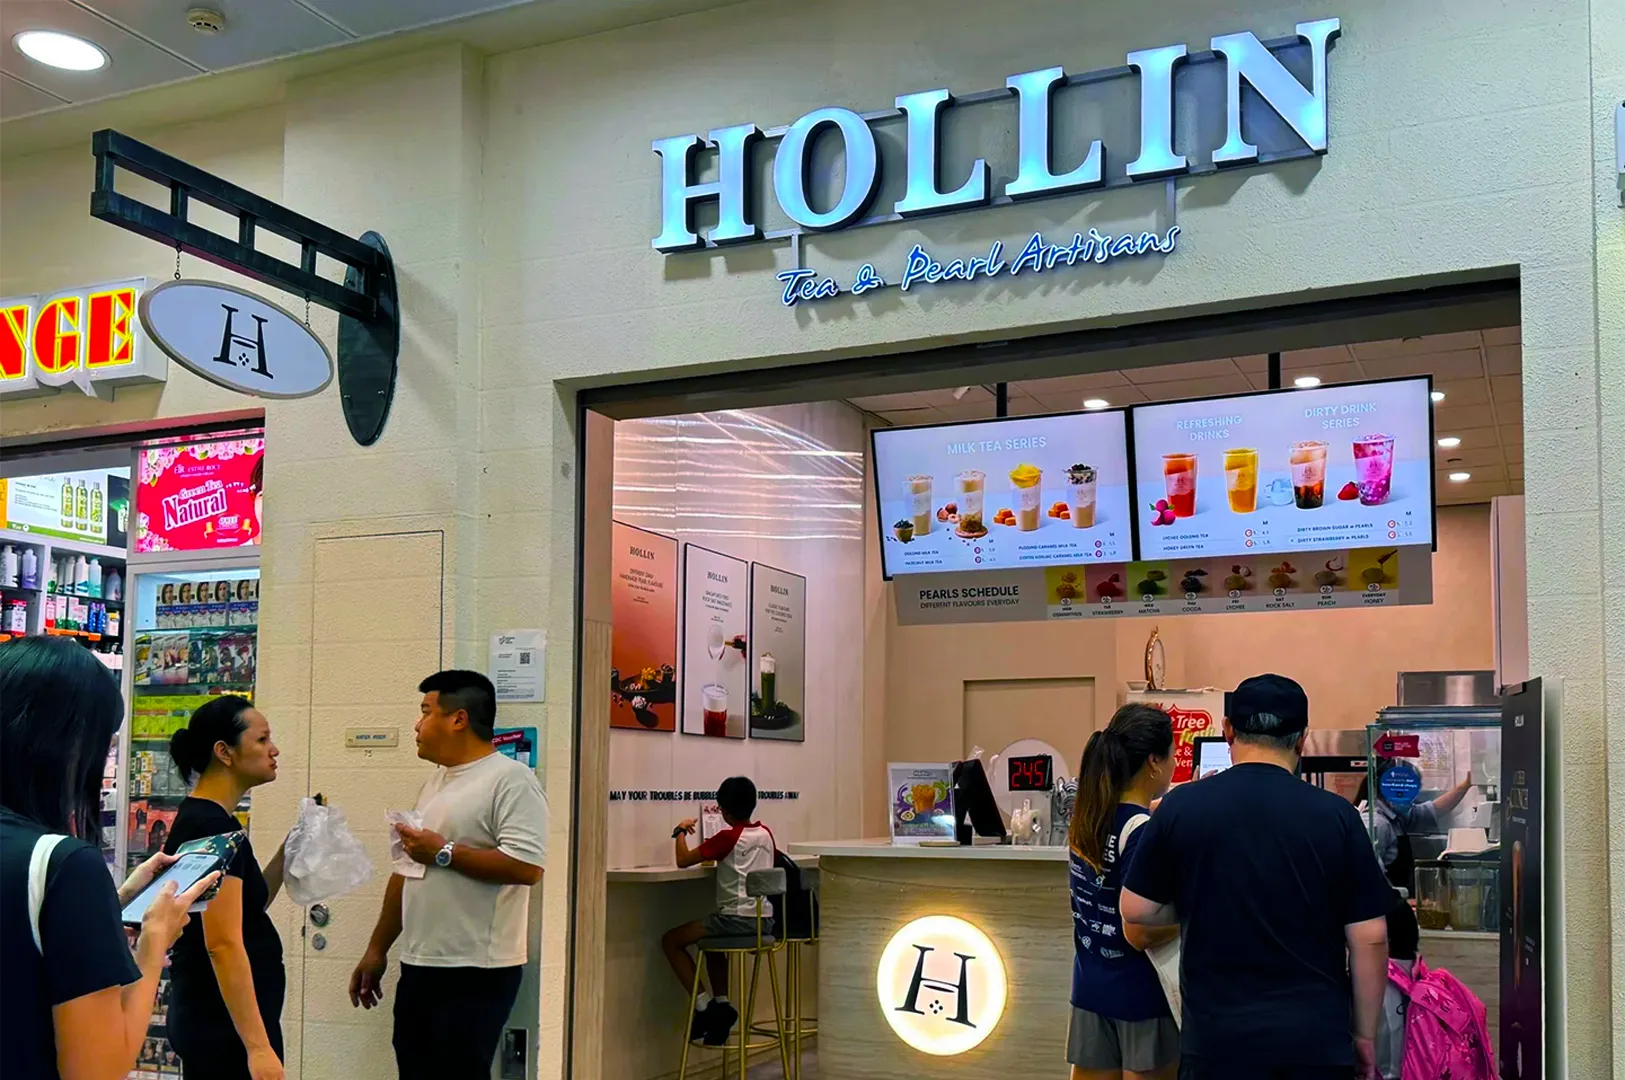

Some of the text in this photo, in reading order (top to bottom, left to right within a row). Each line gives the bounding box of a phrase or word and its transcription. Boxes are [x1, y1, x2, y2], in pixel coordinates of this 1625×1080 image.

[651, 17, 1342, 252] HOLLIN
[777, 225, 1181, 307] Tea & Pearl Artisans
[213, 303, 274, 379] H
[1305, 402, 1377, 418] DIRTY DRINK
[1177, 416, 1243, 430] REFRESHING
[1321, 417, 1360, 430] SERIES
[1190, 429, 1230, 441] DRINKS
[947, 436, 1047, 454] MILK TEA SERIES
[161, 488, 228, 531] Natural
[919, 585, 1019, 600] PEARLS SCHEDULE
[920, 598, 1020, 609] DIFFERENT FLAVOURS EVERYDAY
[1317, 599, 1337, 607] PEACH
[1175, 714, 1206, 729] Tree
[1011, 760, 1044, 788] 245
[609, 791, 627, 801] MAY
[628, 791, 648, 801] YOUR
[650, 791, 683, 801] TROUBLES
[683, 791, 692, 801] BE
[757, 791, 784, 800] TROUBLES
[894, 944, 977, 1028] H
